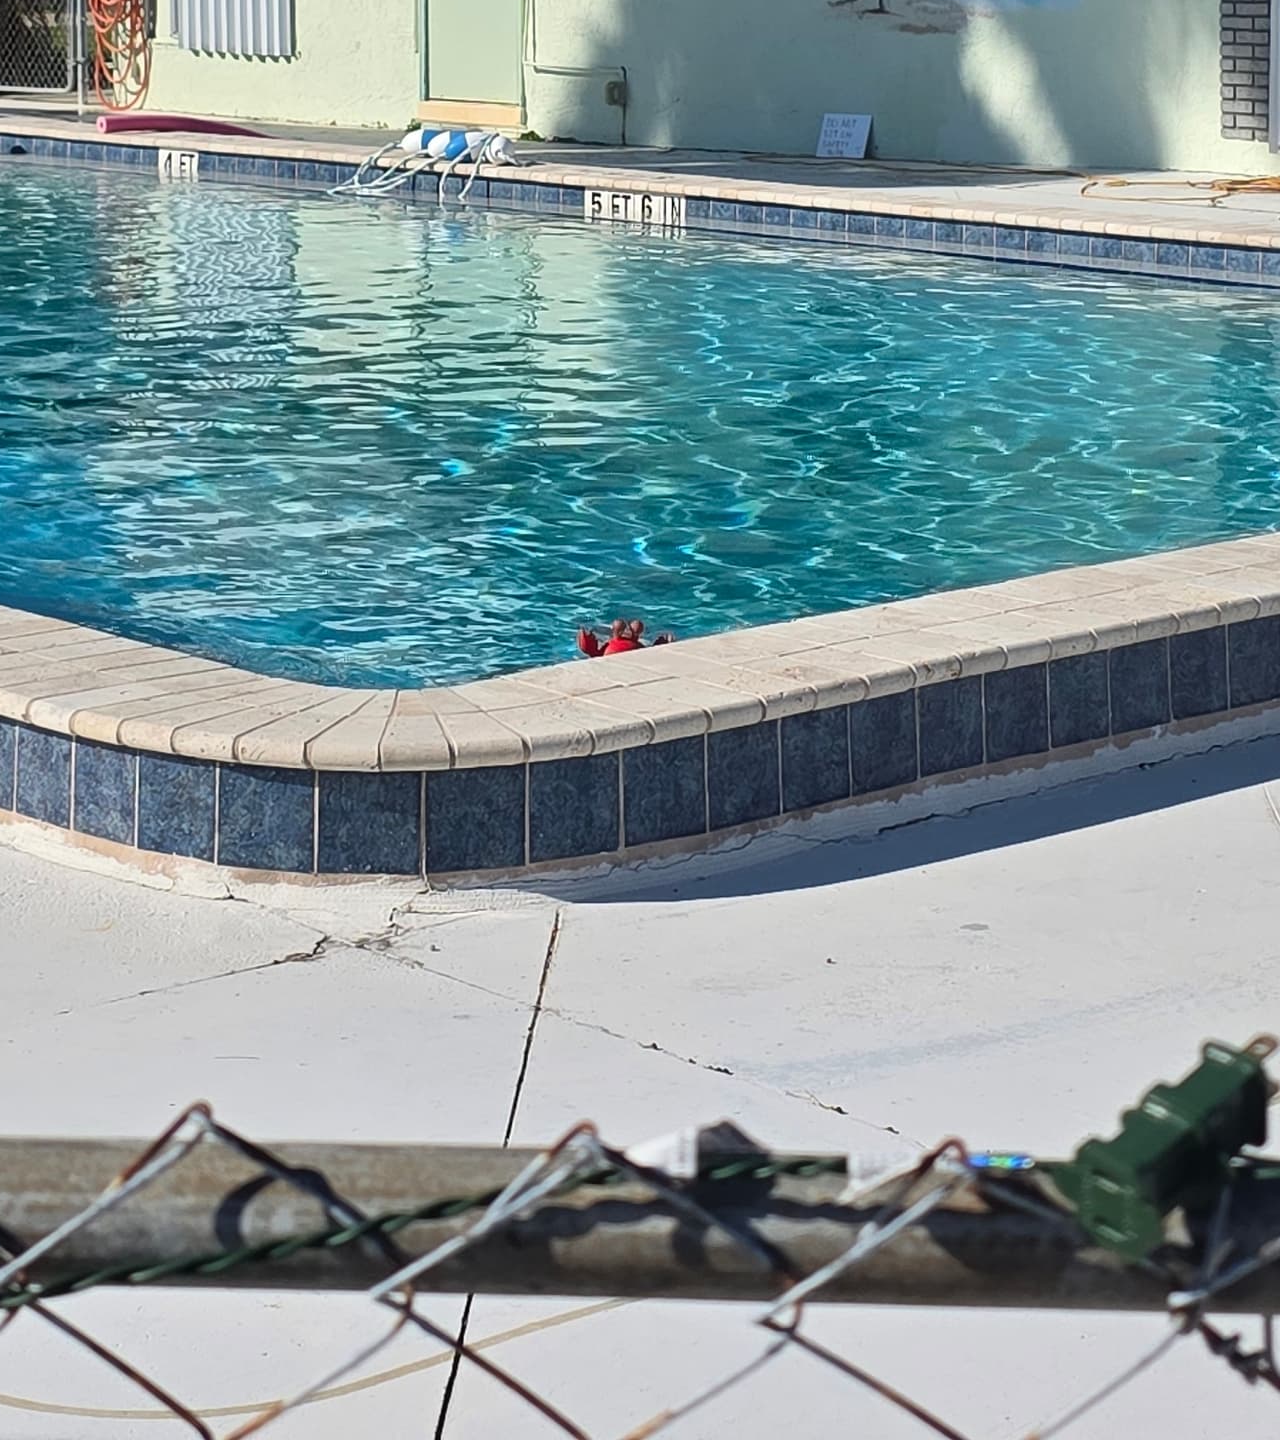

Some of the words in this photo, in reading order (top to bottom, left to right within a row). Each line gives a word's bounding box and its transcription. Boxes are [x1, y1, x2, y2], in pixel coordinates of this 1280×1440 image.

[591, 192, 602, 218] 5
[641, 195, 653, 222] 6
[663, 196, 681, 227] IN
